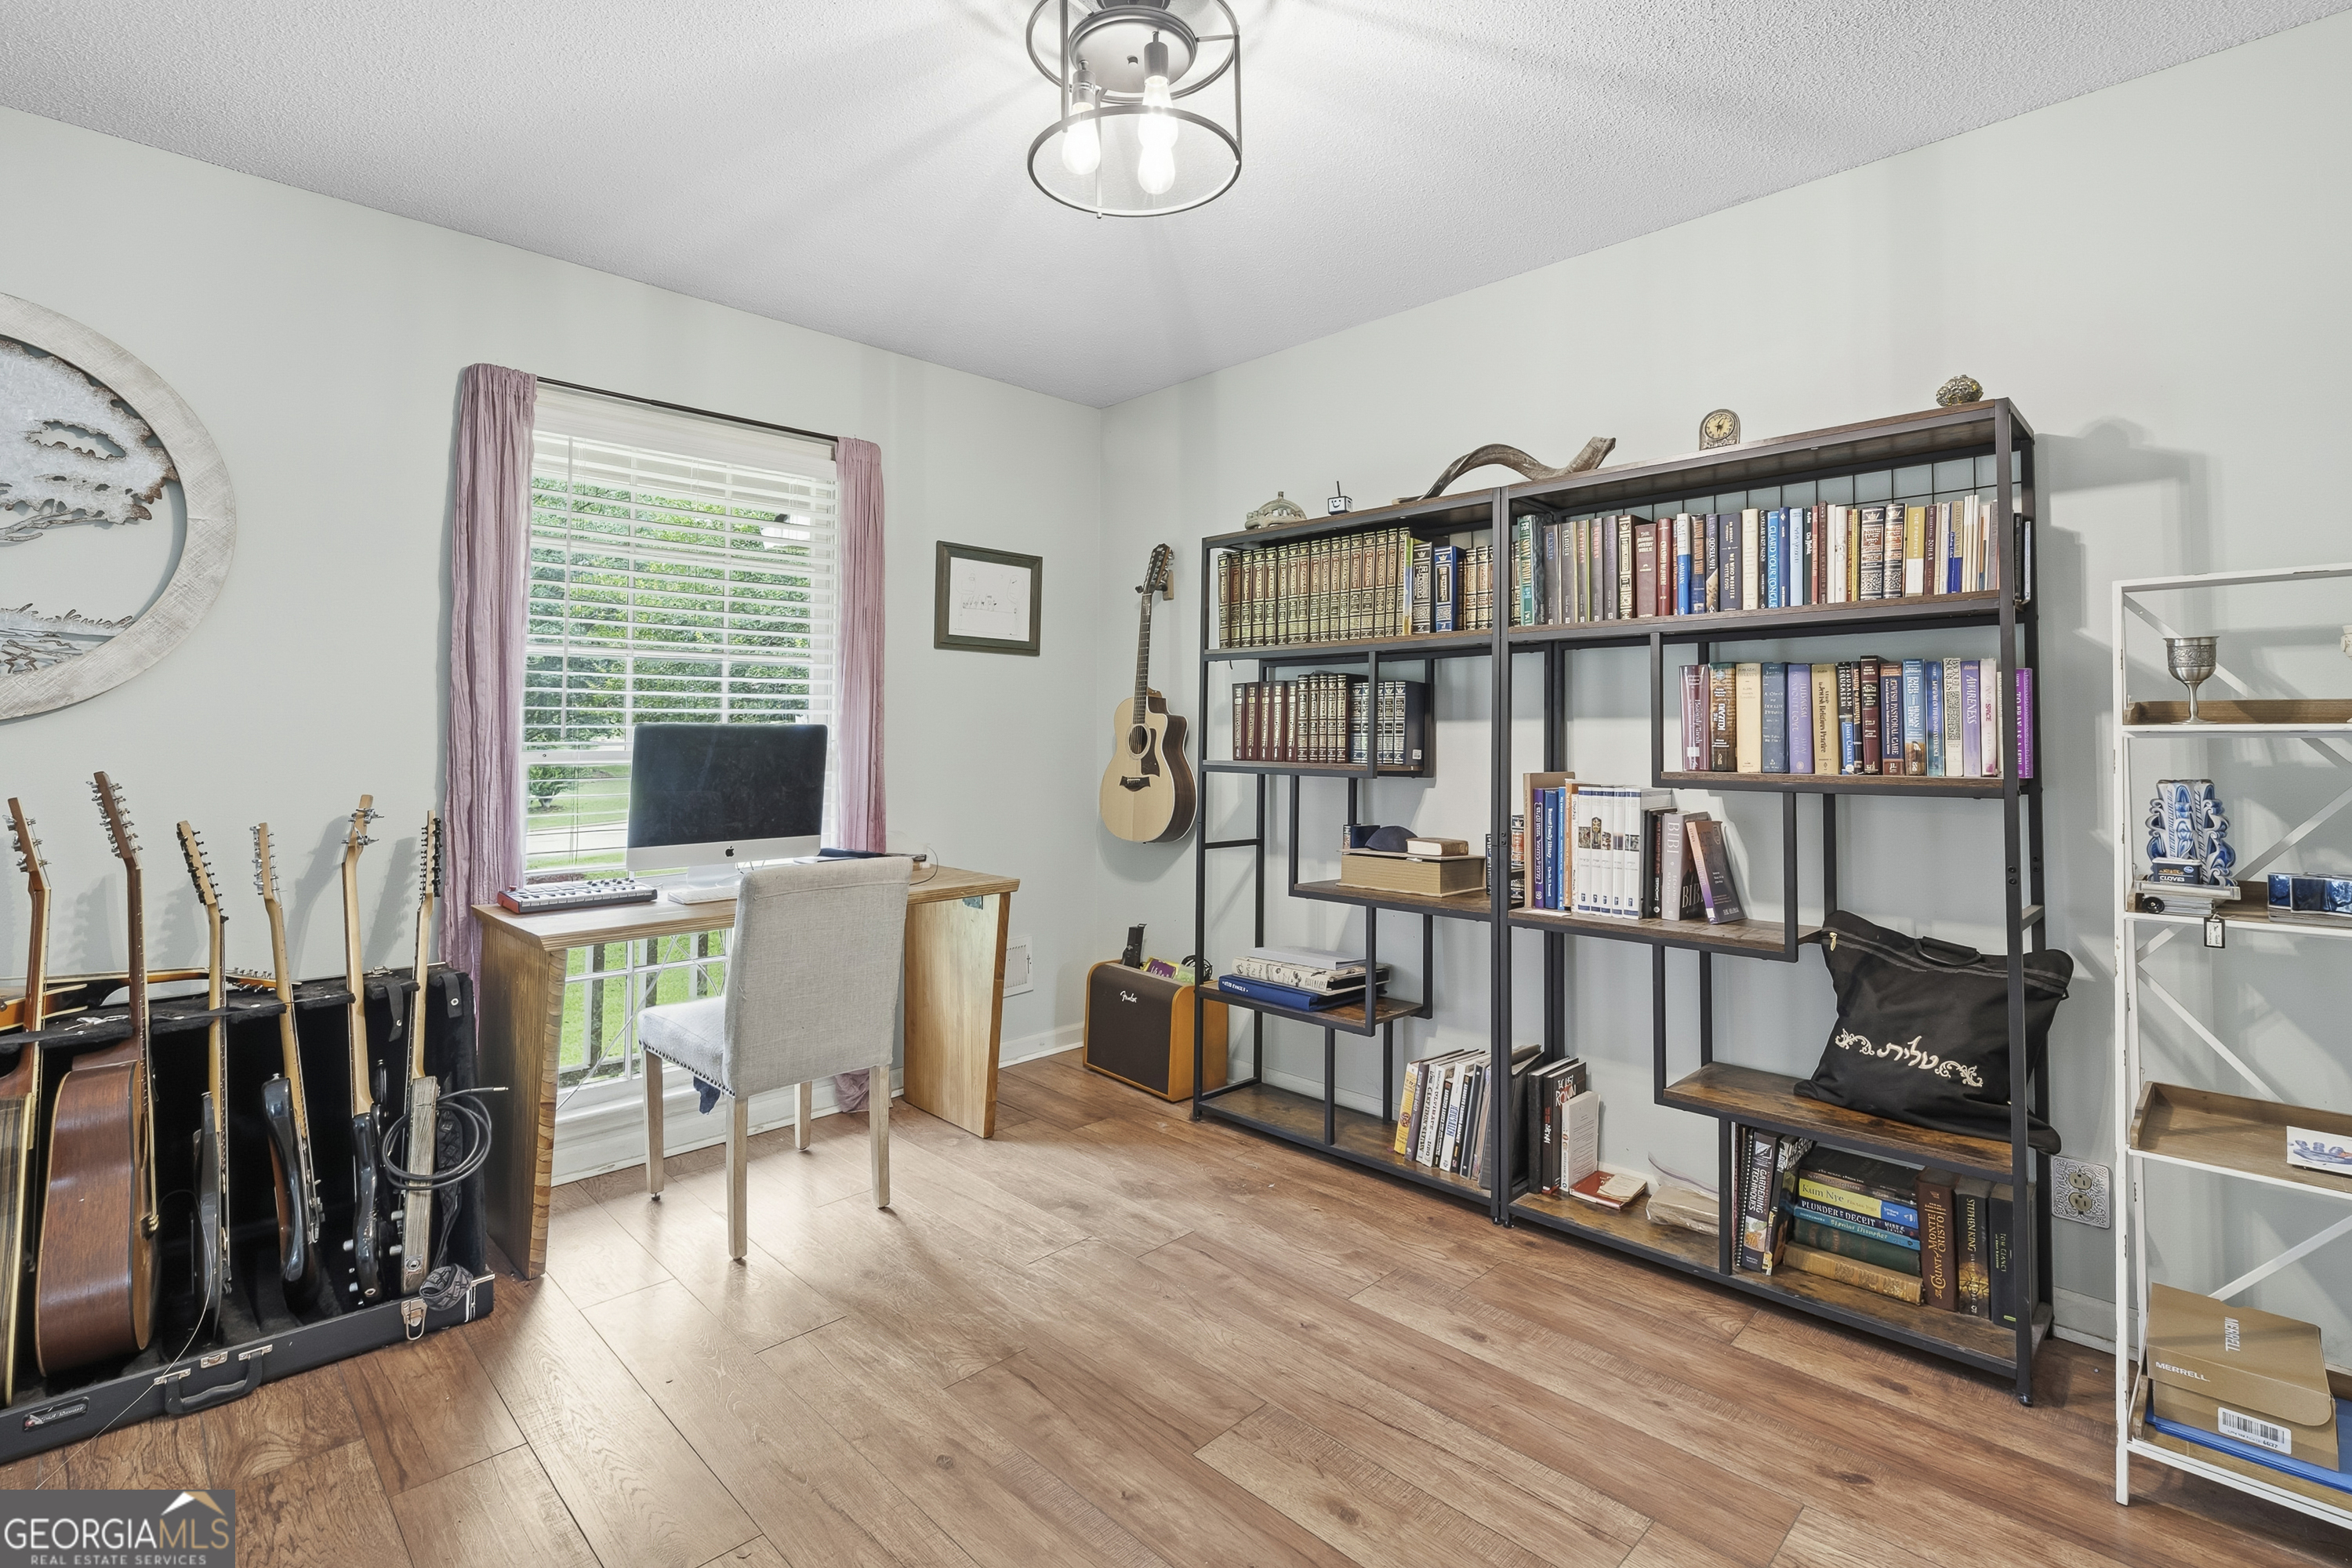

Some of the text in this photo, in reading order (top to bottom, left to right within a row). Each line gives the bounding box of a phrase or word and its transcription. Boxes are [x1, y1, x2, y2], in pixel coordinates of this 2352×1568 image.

[1769, 525, 1777, 608] GUARD YOUR TONGUE
[1966, 675, 1977, 724] AWARENESS
[1667, 822, 1680, 854] BIBI
[1682, 884, 1704, 909] BIB
[1877, 1035, 1940, 1070] טלית
[1755, 1169, 1767, 1214] GARDENING
[1802, 1184, 1824, 1198] Kum
[1825, 1189, 1844, 1203] Nye
[1802, 1200, 1838, 1217] PLUNDER
[1845, 1212, 1875, 1227] DECEIT
[1966, 1199, 1975, 1231] STEPHEN
[1927, 1213, 1937, 1249] MONTE
[1936, 1215, 1946, 1252] CRISTO
[1967, 1231, 1976, 1251] KING
[1930, 1257, 1946, 1289] COUNT
[2224, 1316, 2241, 1352] MERRELL
[2155, 1361, 2208, 1382] MERRELL
